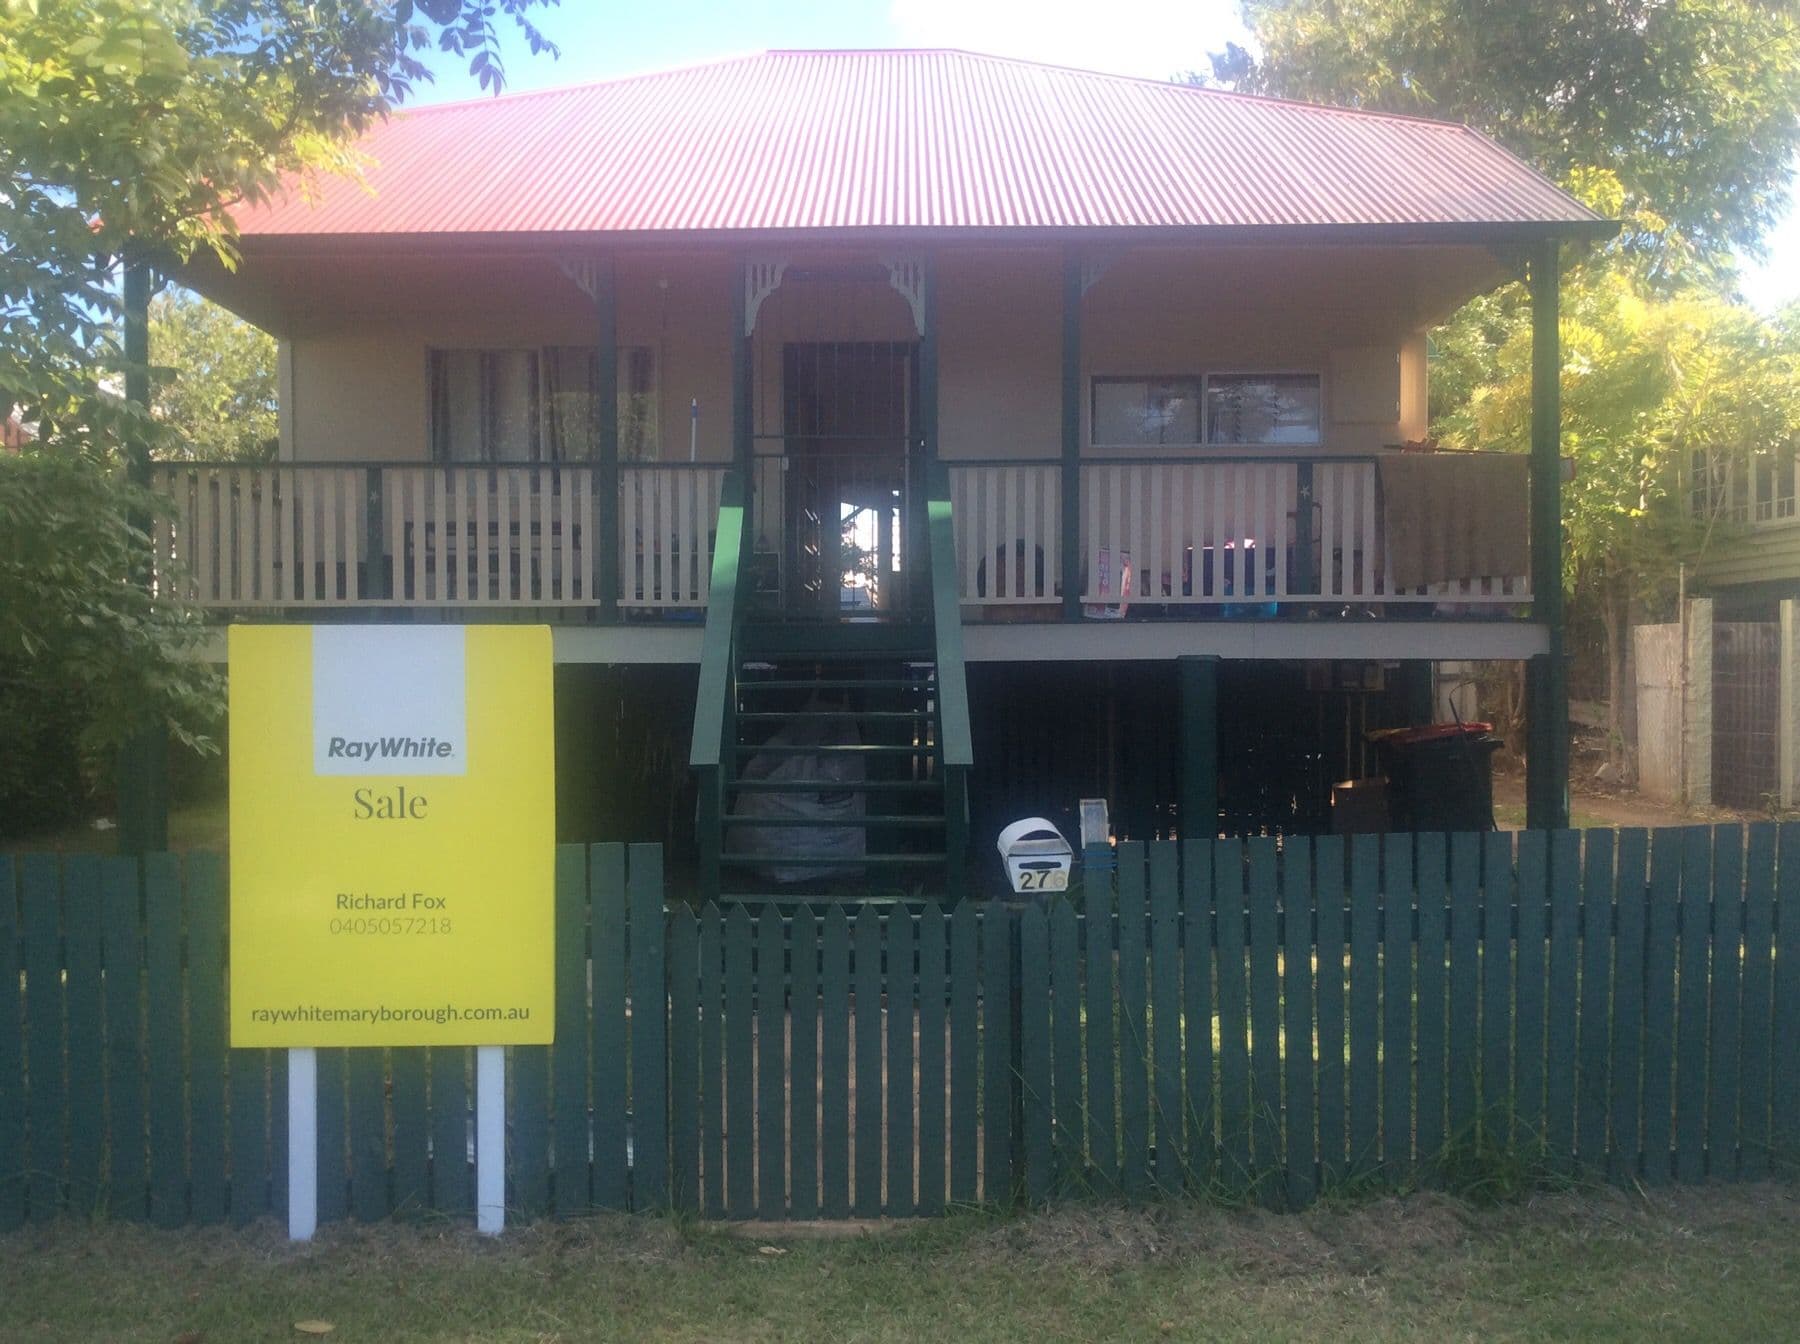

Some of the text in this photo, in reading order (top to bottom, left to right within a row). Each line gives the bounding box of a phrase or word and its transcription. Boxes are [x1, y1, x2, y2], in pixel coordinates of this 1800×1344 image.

[354, 786, 428, 820] Sale
[336, 893, 446, 910] Richard Fox
[329, 918, 452, 935] 0405057218
[251, 1004, 531, 1025] raywhitemaryborough.com.au
